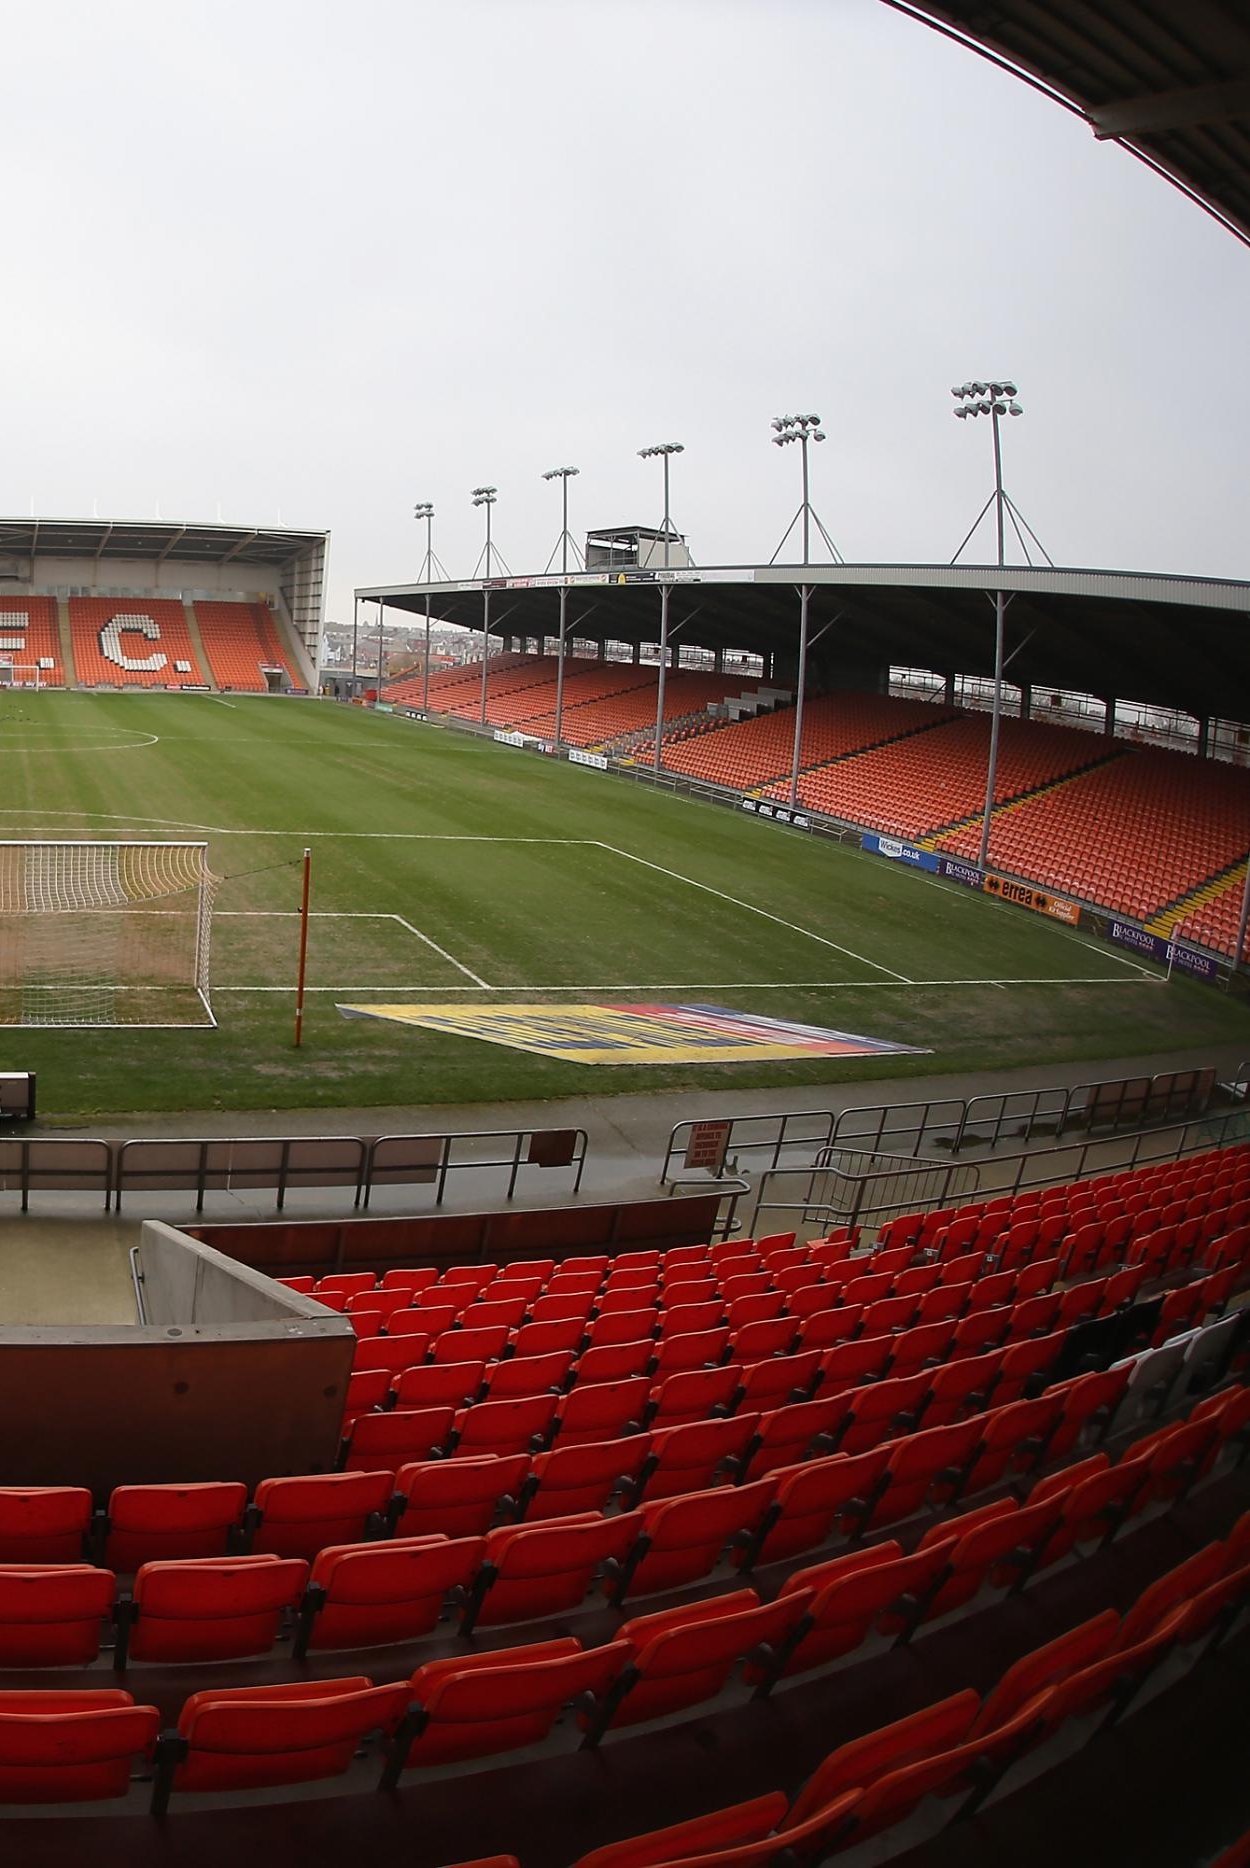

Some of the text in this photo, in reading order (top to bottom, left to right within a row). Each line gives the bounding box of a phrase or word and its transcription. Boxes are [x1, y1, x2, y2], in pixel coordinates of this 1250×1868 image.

[945, 861, 981, 880] BLACKPOOL
[1112, 922, 1156, 946] BLACKPOOL
[1165, 945, 1211, 970] BLACKPOOL
